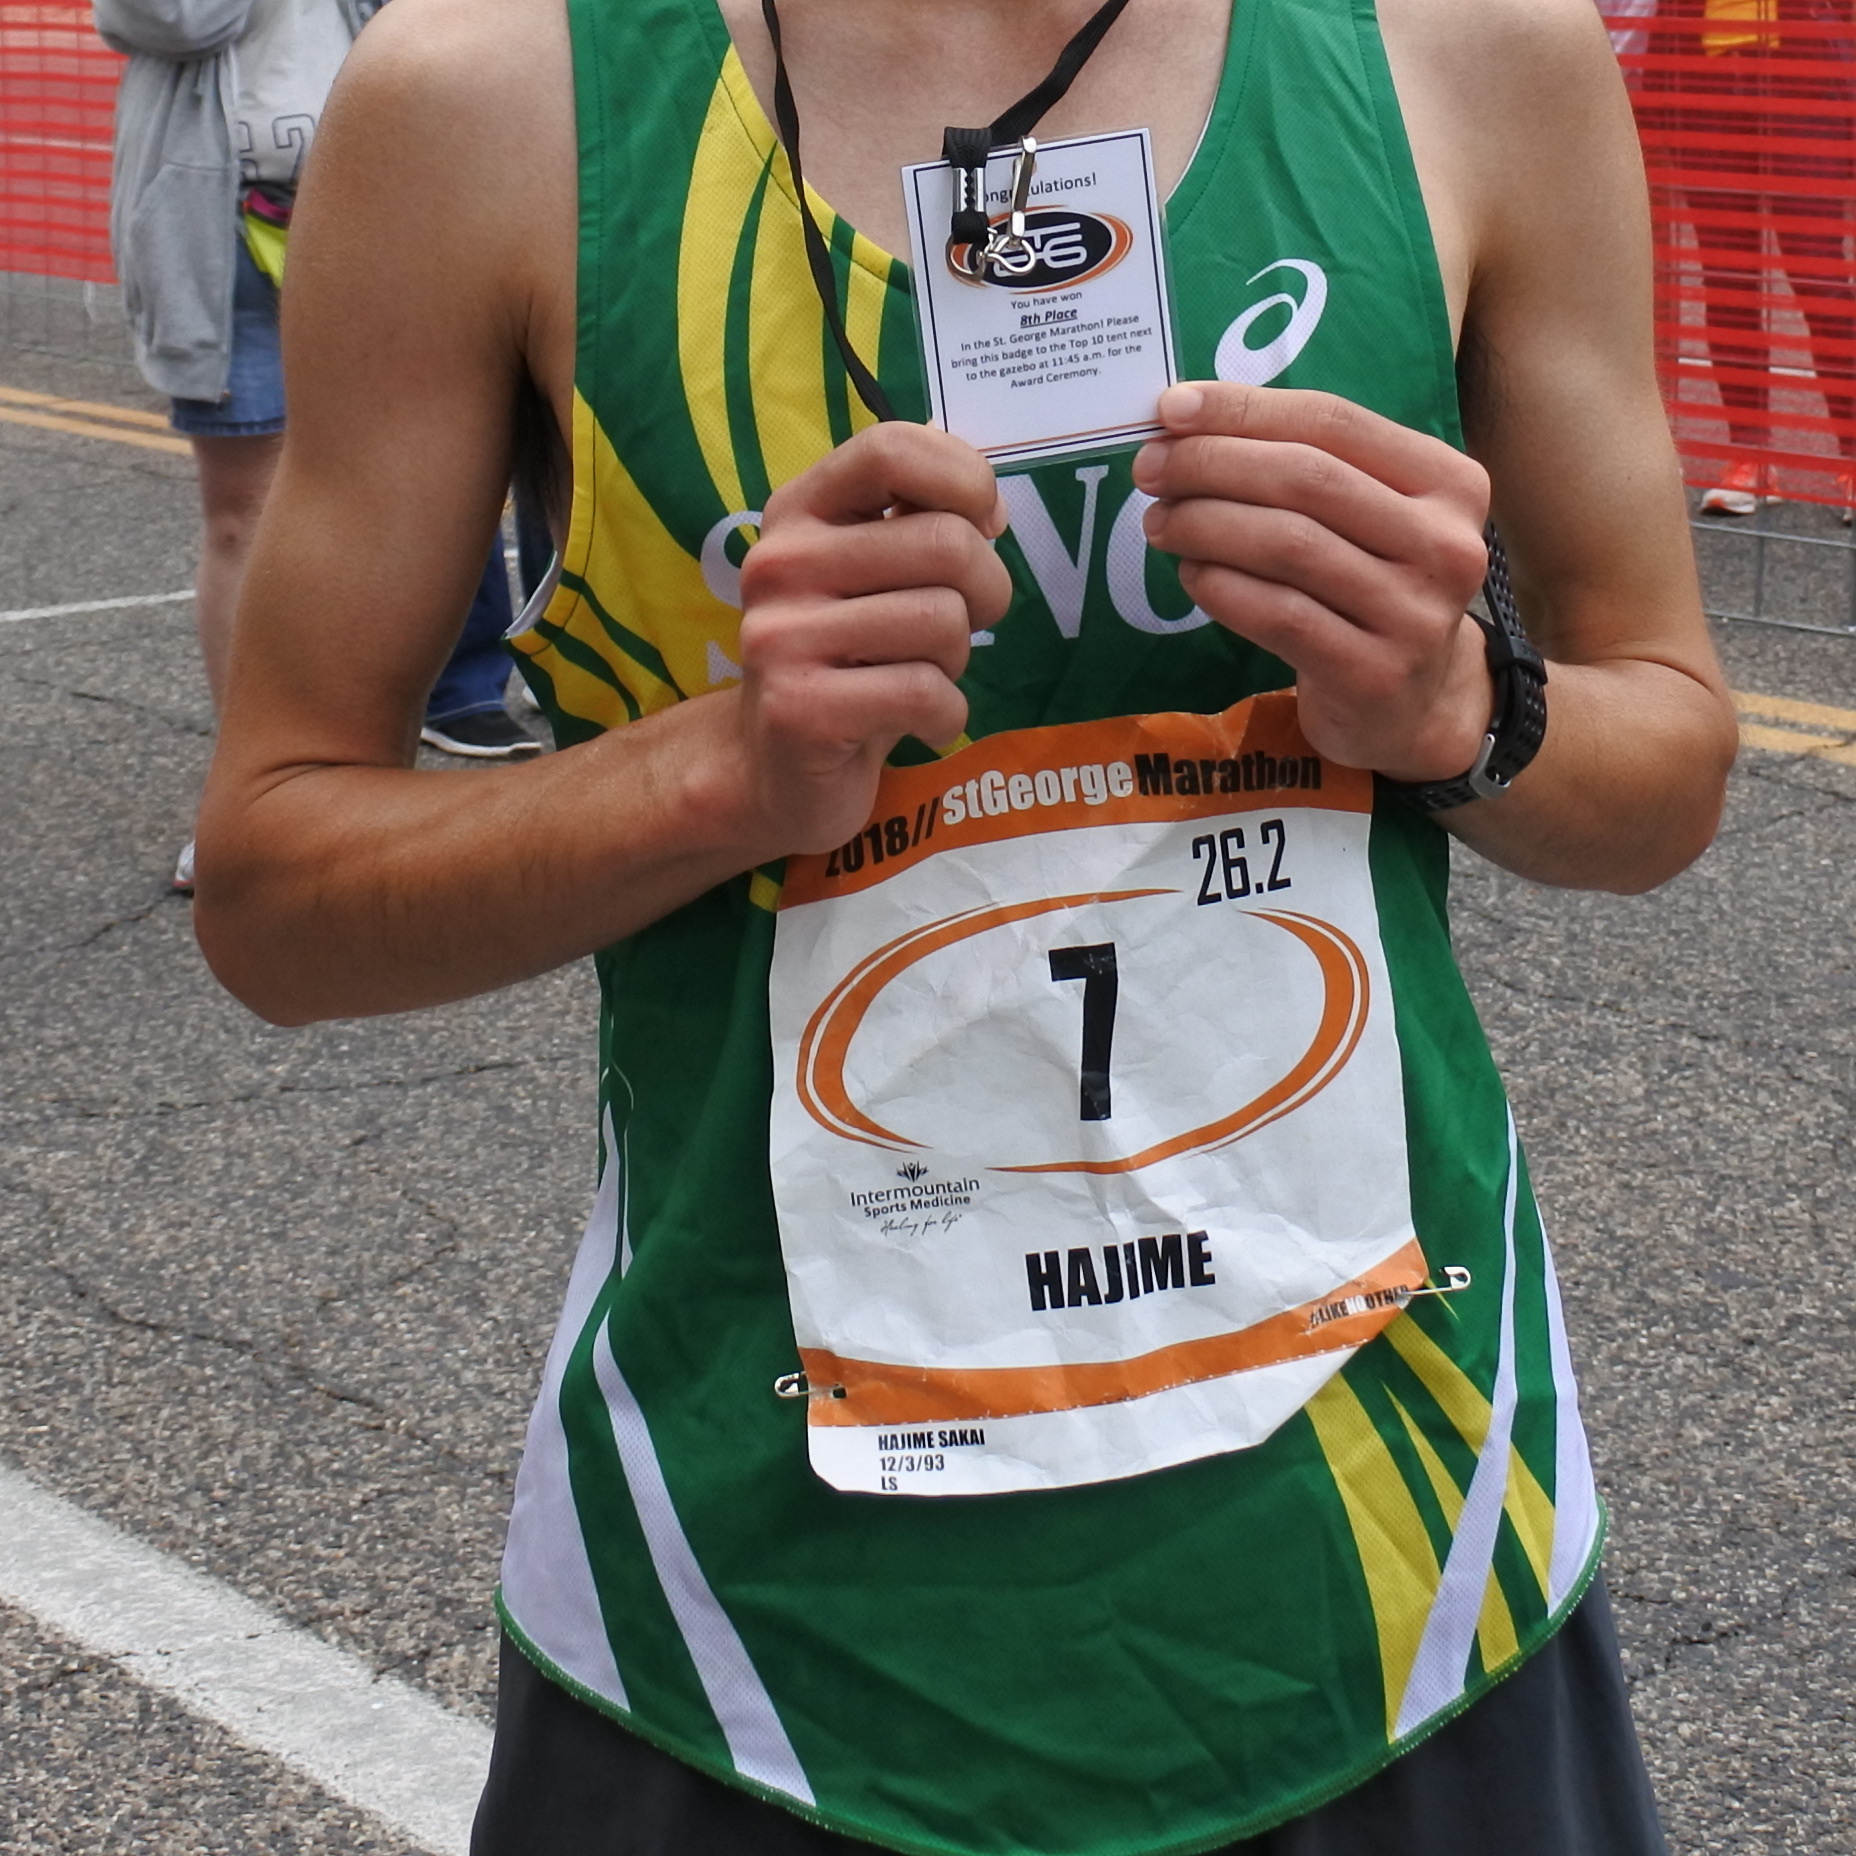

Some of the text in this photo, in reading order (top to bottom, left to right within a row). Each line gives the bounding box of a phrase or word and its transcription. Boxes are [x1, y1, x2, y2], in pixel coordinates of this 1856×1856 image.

[1011, 292, 1083, 311] You have won
[1020, 308, 1078, 327] 8th Place
[961, 314, 1140, 352] In the St. George Marathon! Please
[951, 326, 1153, 369] bring this badge to the Top 10 tent next
[966, 344, 1142, 382] to the gazebo at 11:45 a.m. for the
[1010, 366, 1102, 389] Award Ceremony.
[1191, 818, 1292, 906] 26.2
[1048, 942, 1119, 1121] 7
[850, 1177, 980, 1207] Intermountain
[864, 1194, 971, 1219] Sports Medicine
[1025, 1230, 1216, 1311] HAJIME
[878, 1428, 985, 1451] HAJIME SAKAI
[880, 1453, 945, 1472] 12/3/93
[881, 1476, 898, 1491] LS
